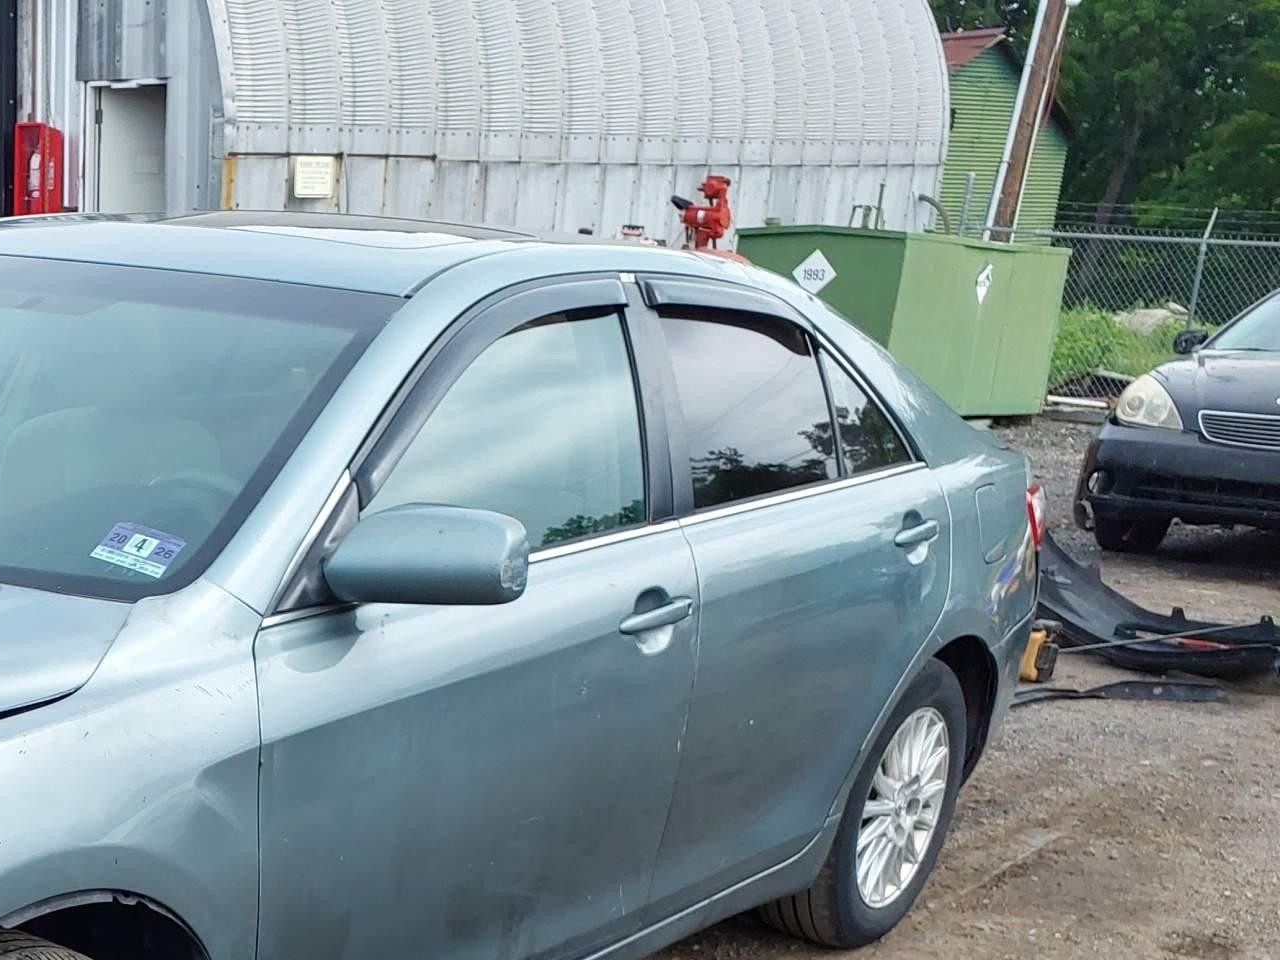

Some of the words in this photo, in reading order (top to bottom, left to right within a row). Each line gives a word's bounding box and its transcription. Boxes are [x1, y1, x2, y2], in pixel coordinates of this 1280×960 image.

[803, 268, 826, 281] 1993
[109, 532, 128, 545] 20
[133, 537, 148, 553] 4
[153, 546, 175, 559] 26
